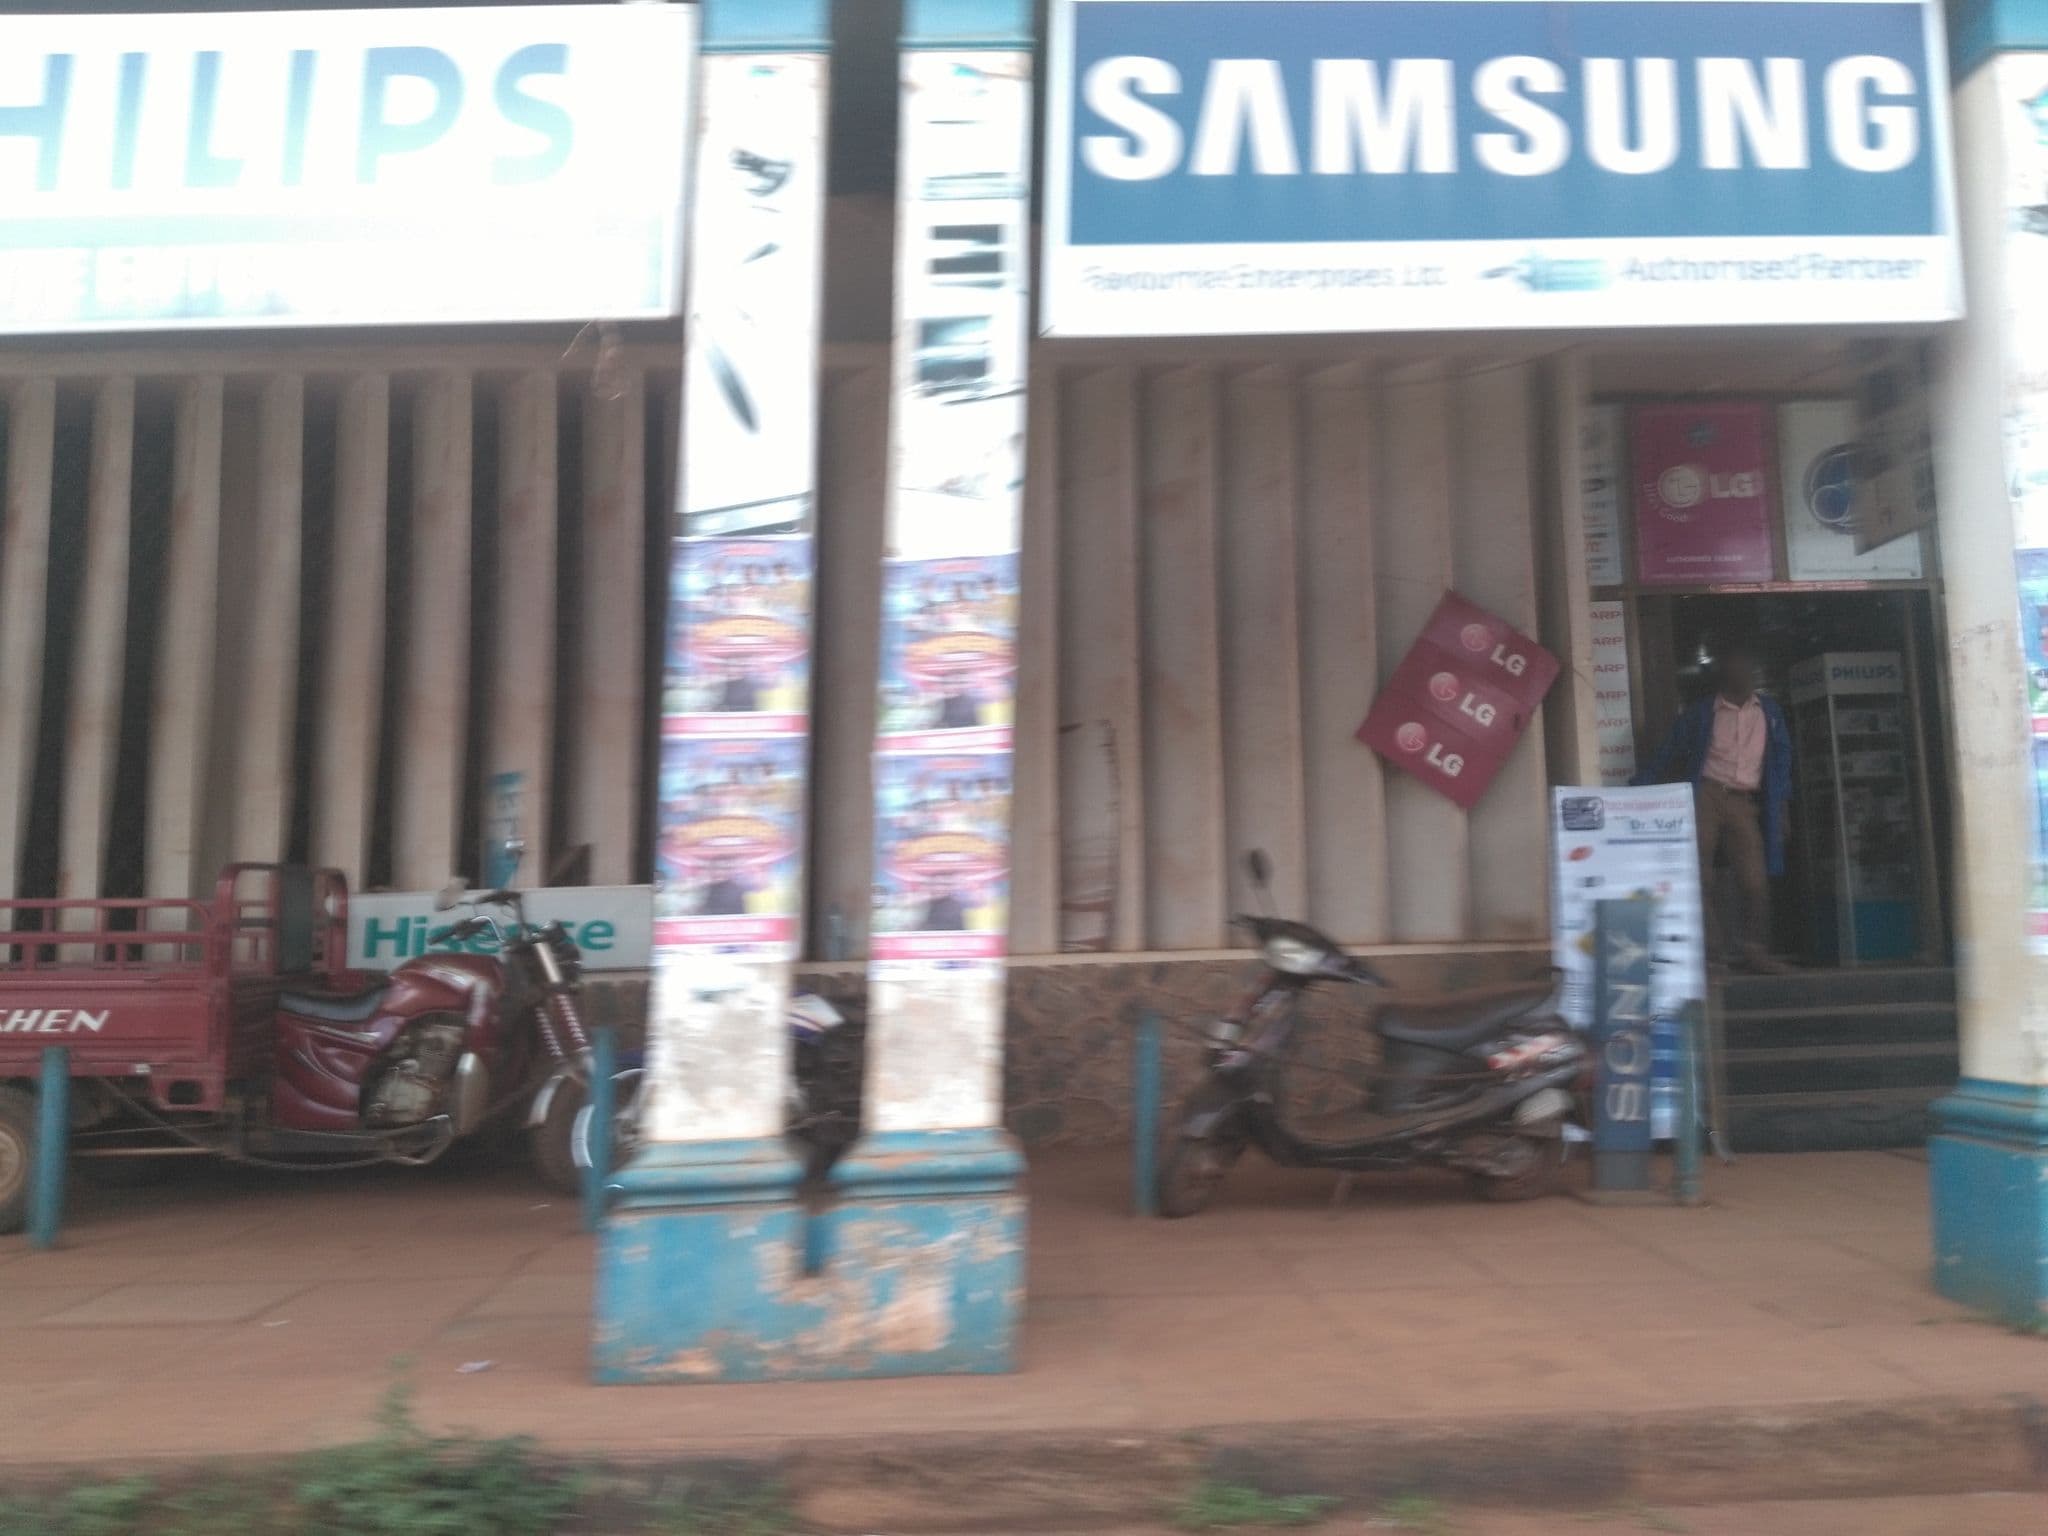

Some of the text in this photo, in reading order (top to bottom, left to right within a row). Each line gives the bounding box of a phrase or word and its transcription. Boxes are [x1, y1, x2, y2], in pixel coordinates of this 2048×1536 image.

[1083, 54, 1920, 181] SAMSUNG
[1709, 471, 1761, 499] LG
[1490, 644, 1527, 676] LG
[1458, 693, 1496, 727] LG
[1426, 743, 1464, 777] LG
[1604, 931, 1650, 1123] SONY
